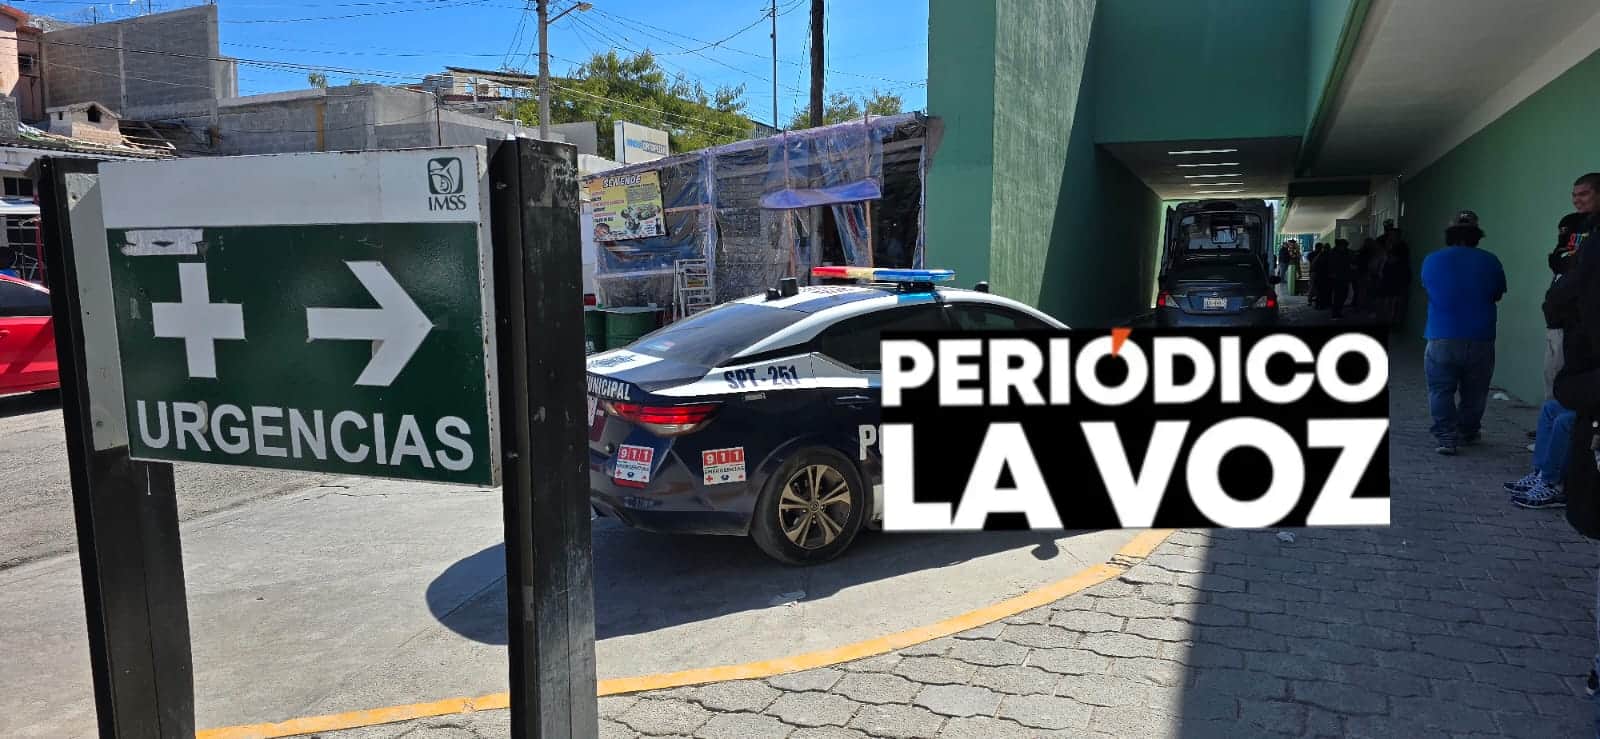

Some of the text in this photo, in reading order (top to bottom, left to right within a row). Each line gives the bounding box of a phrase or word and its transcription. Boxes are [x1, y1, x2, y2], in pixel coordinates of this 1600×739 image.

[428, 194, 467, 211] IMSS
[724, 368, 758, 389] SPT
[768, 364, 800, 386] 251
[586, 375, 631, 401] UNICIPAL
[136, 400, 474, 471] URGENCIAS
[620, 448, 650, 462] 911
[706, 451, 741, 464] 911
